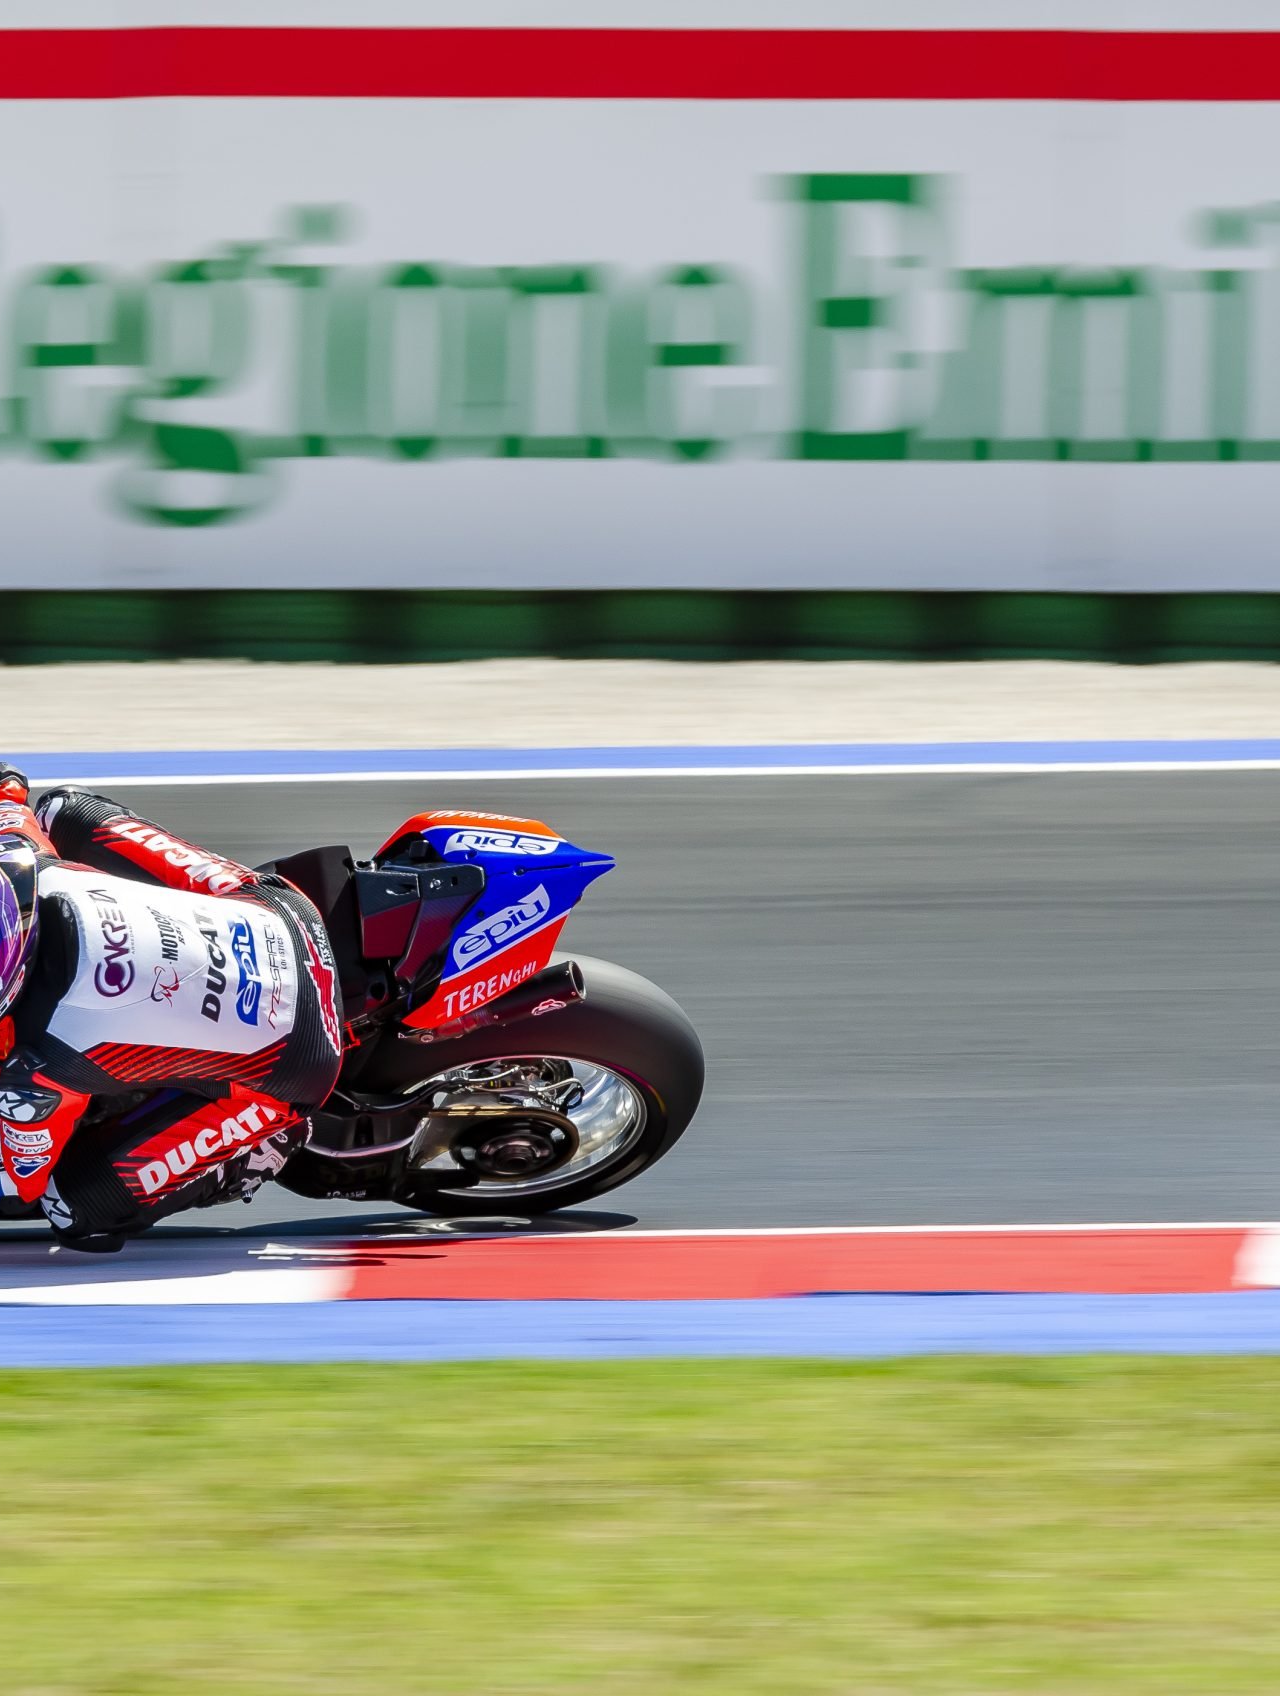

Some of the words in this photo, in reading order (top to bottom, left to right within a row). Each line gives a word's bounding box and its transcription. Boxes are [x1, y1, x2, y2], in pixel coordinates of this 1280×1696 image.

[457, 833, 547, 852] epiu
[458, 898, 546, 956] epiu
[24, 1143, 50, 1153] PVM
[136, 1101, 277, 1196] DUCATI
